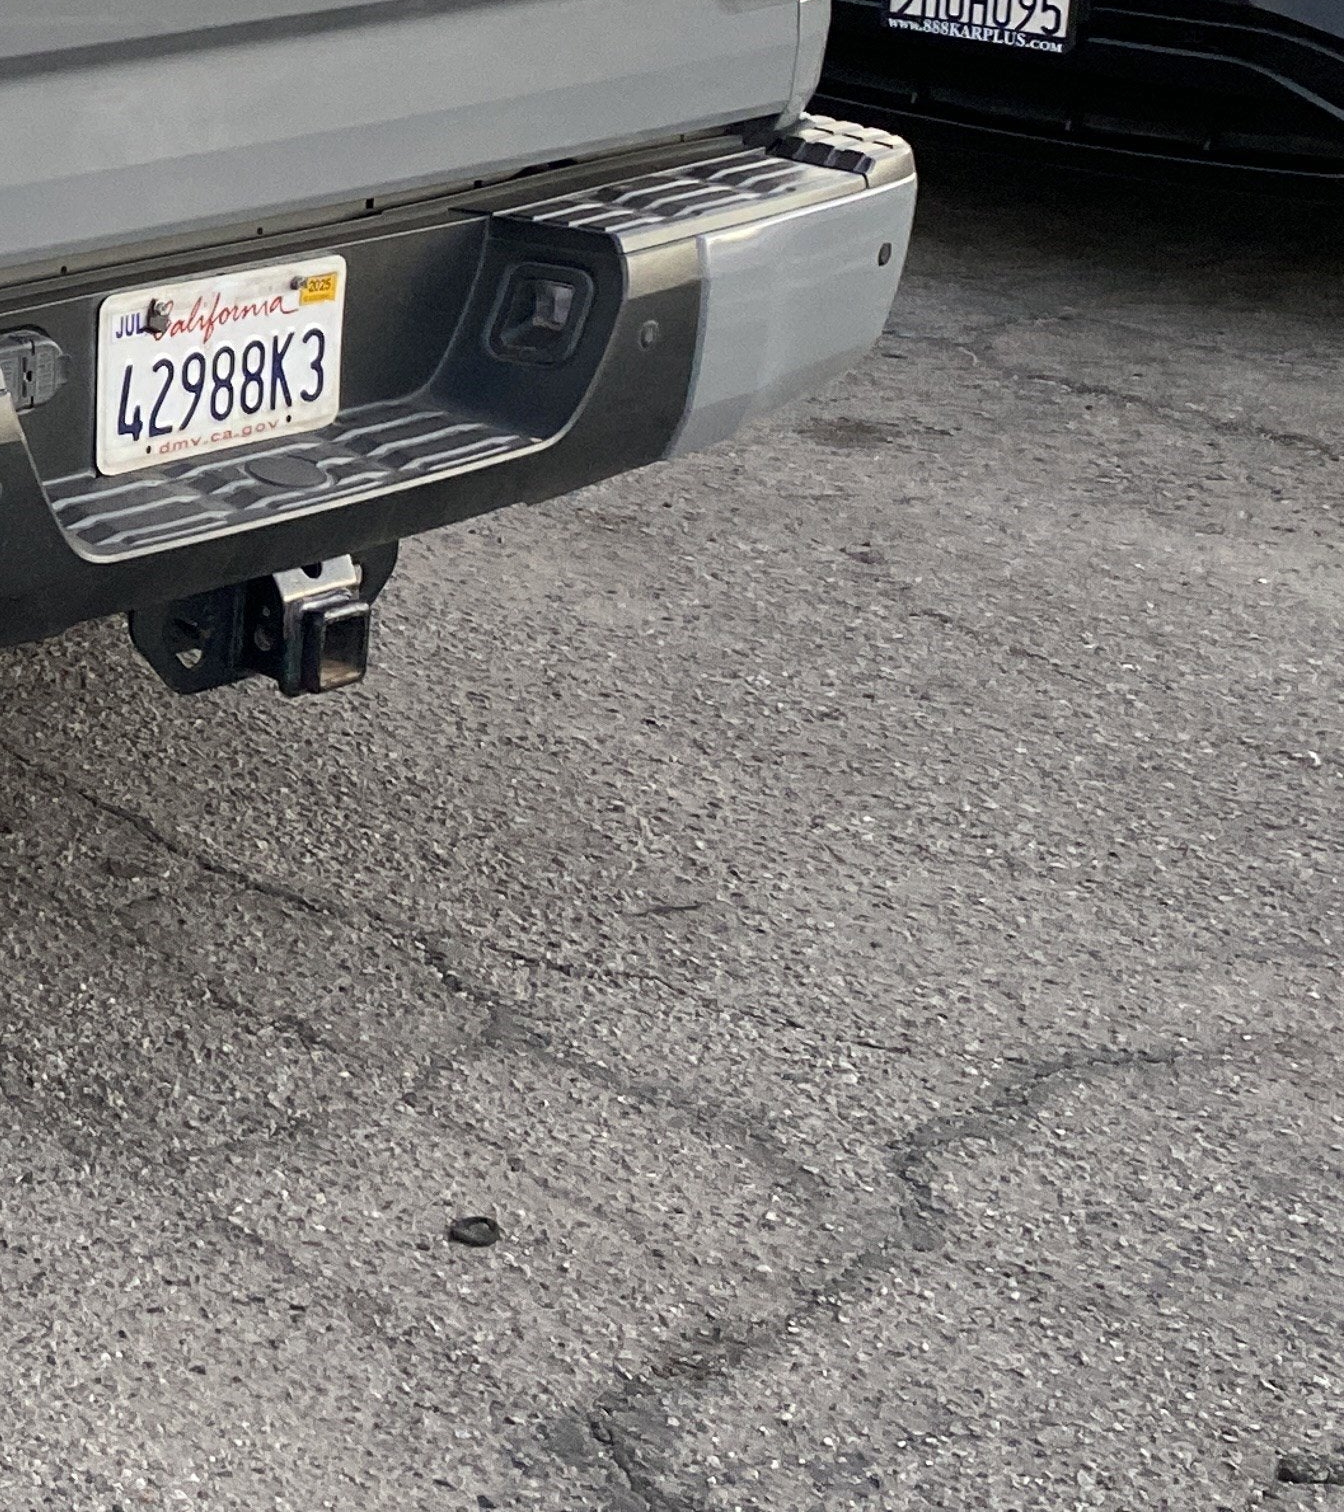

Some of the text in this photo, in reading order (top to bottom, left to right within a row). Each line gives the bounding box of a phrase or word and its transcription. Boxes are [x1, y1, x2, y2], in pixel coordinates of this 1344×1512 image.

[115, 312, 144, 338] JUL
[117, 327, 326, 442] 42988K3
[158, 419, 281, 456] dmv.ca.gov
